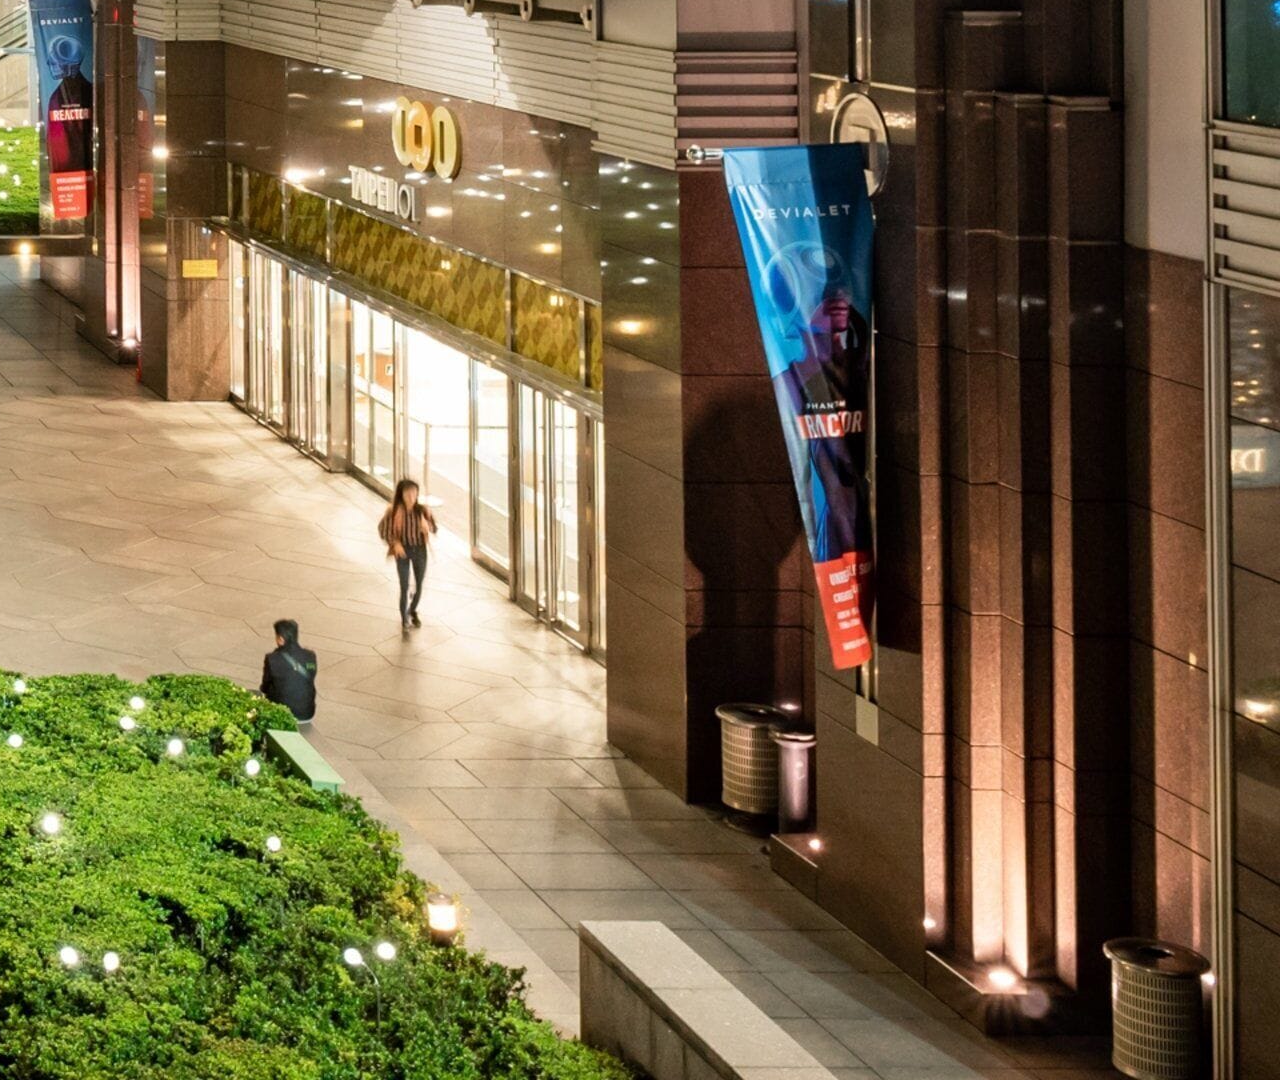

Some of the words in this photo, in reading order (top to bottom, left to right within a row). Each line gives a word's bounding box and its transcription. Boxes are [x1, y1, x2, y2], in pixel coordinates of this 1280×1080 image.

[40, 16, 84, 26] DEVIALET
[753, 204, 851, 220] DEVIALET
[806, 399, 847, 410] PHANTM
